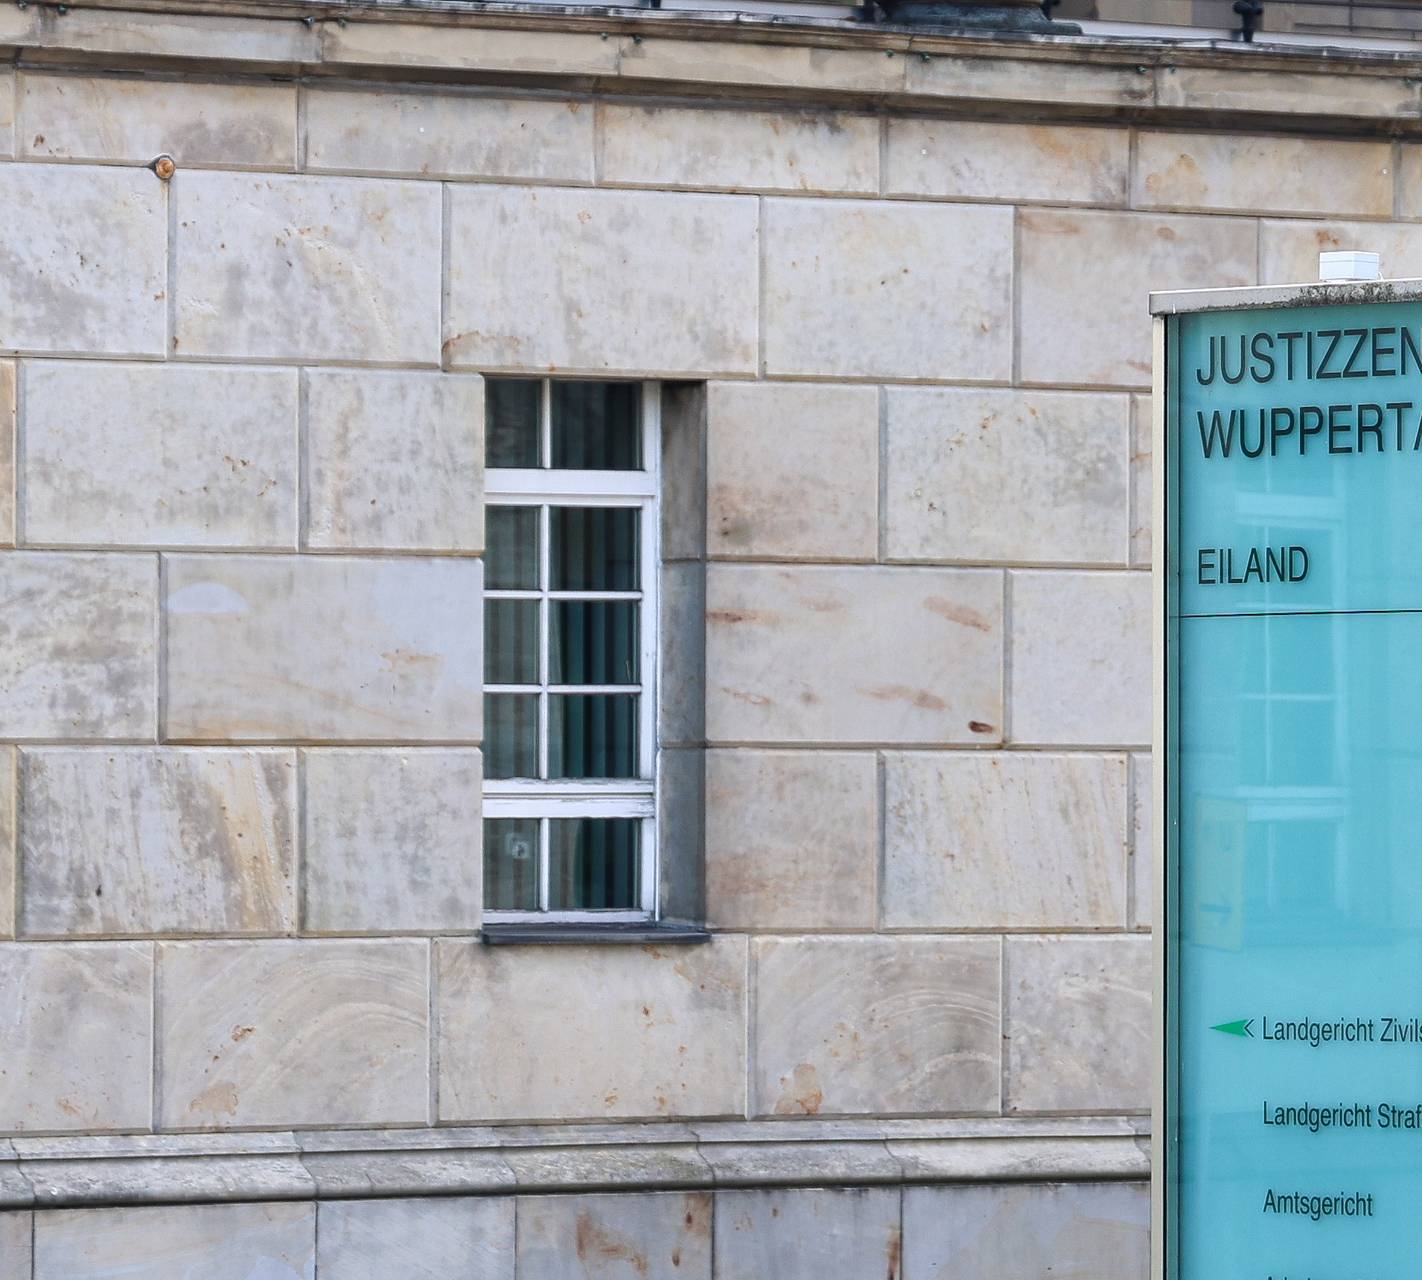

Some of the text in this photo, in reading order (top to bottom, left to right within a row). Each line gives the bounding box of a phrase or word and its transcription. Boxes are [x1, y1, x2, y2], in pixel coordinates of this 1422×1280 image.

[1197, 545, 1309, 585] EILAND
[1262, 1016, 1374, 1047] Landgericht
[1262, 1100, 1372, 1133] Landgericht
[1262, 1189, 1374, 1221] Amtsgericht
